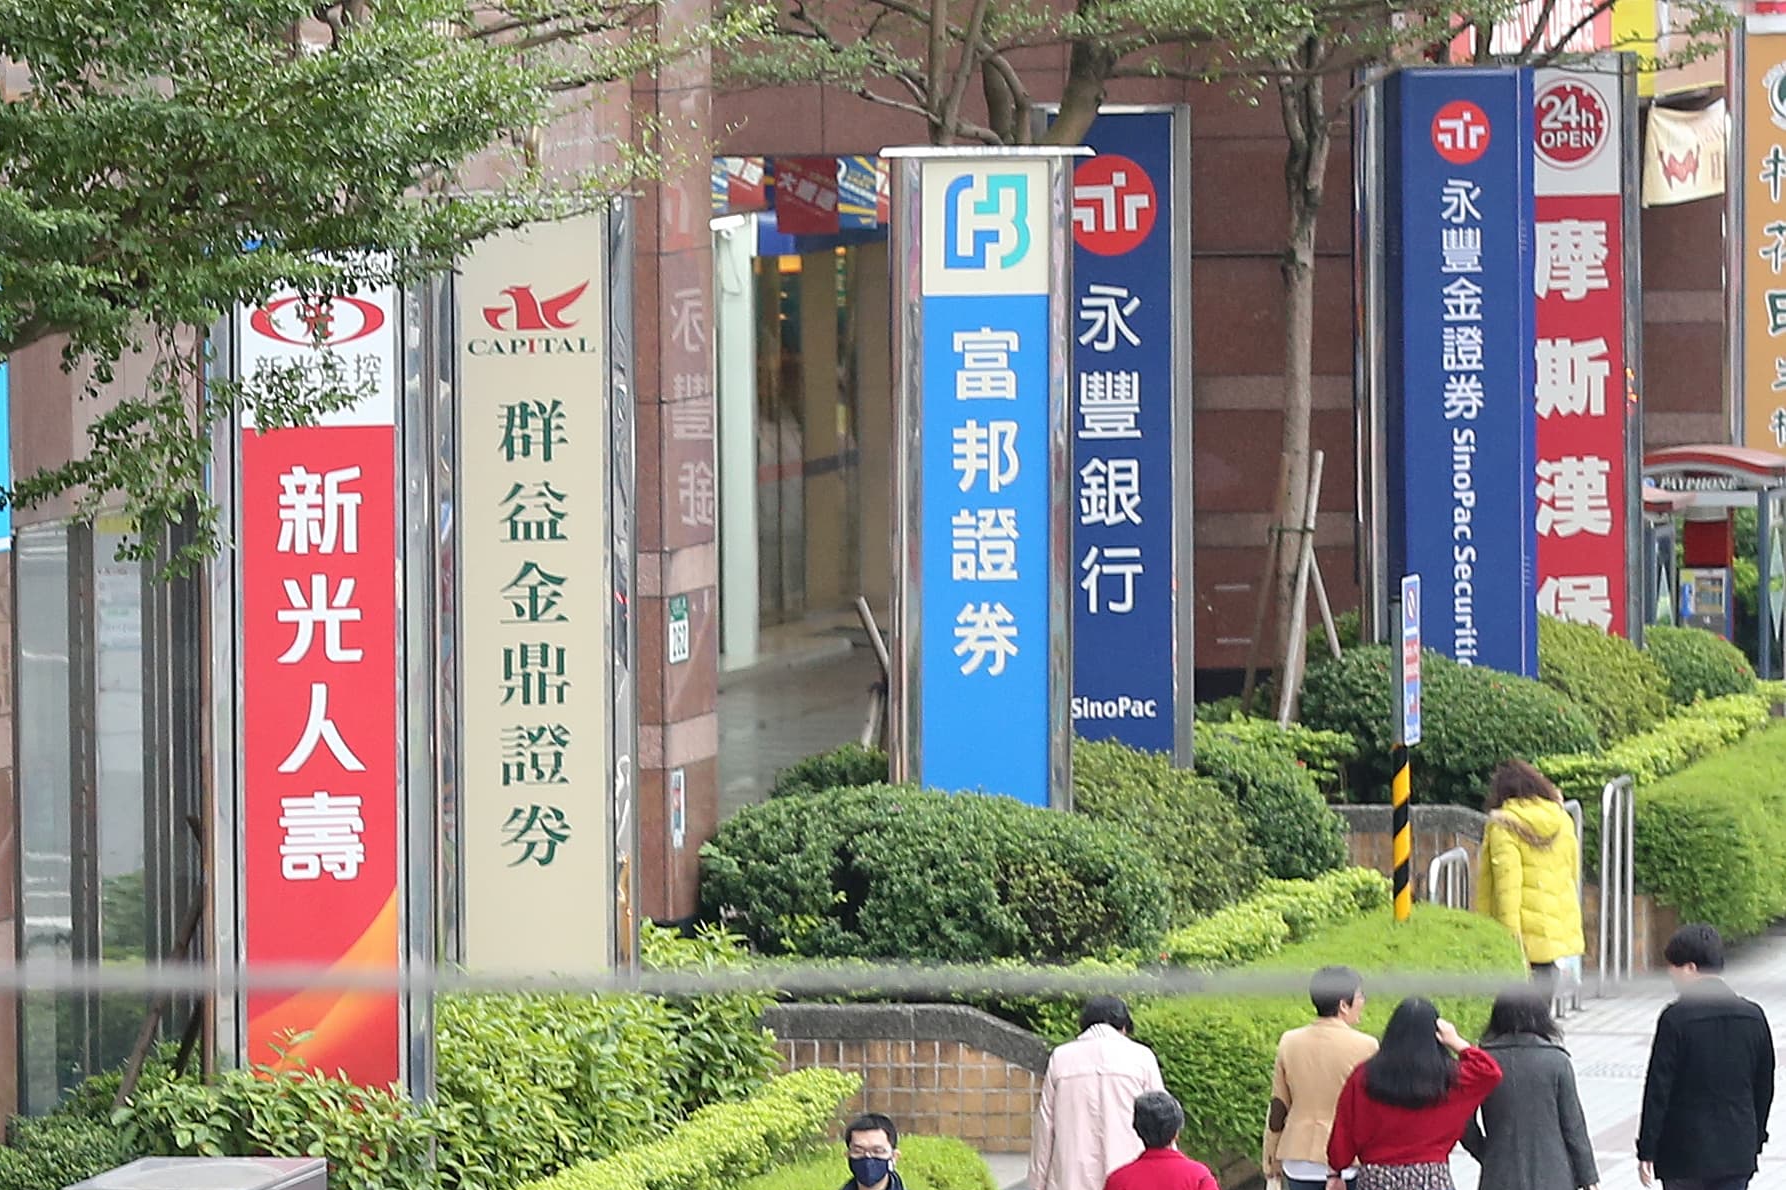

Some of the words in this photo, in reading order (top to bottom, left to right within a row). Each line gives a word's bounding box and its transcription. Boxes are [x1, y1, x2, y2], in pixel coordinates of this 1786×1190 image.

[1540, 96, 1594, 129] 24h
[1540, 130, 1596, 149] OPEN
[467, 337, 596, 356] CAPITAL
[1441, 178, 1484, 420] 永豐金證券
[951, 327, 1020, 676] 富邦證券
[1077, 284, 1143, 615] 永豐銀行
[1452, 427, 1476, 540] SinoPac
[1659, 475, 1738, 491] PAYPHONE
[276, 464, 366, 883] 新光人壽
[497, 398, 571, 868] 群益金鼎證券
[1071, 696, 1157, 719] SinoPac
